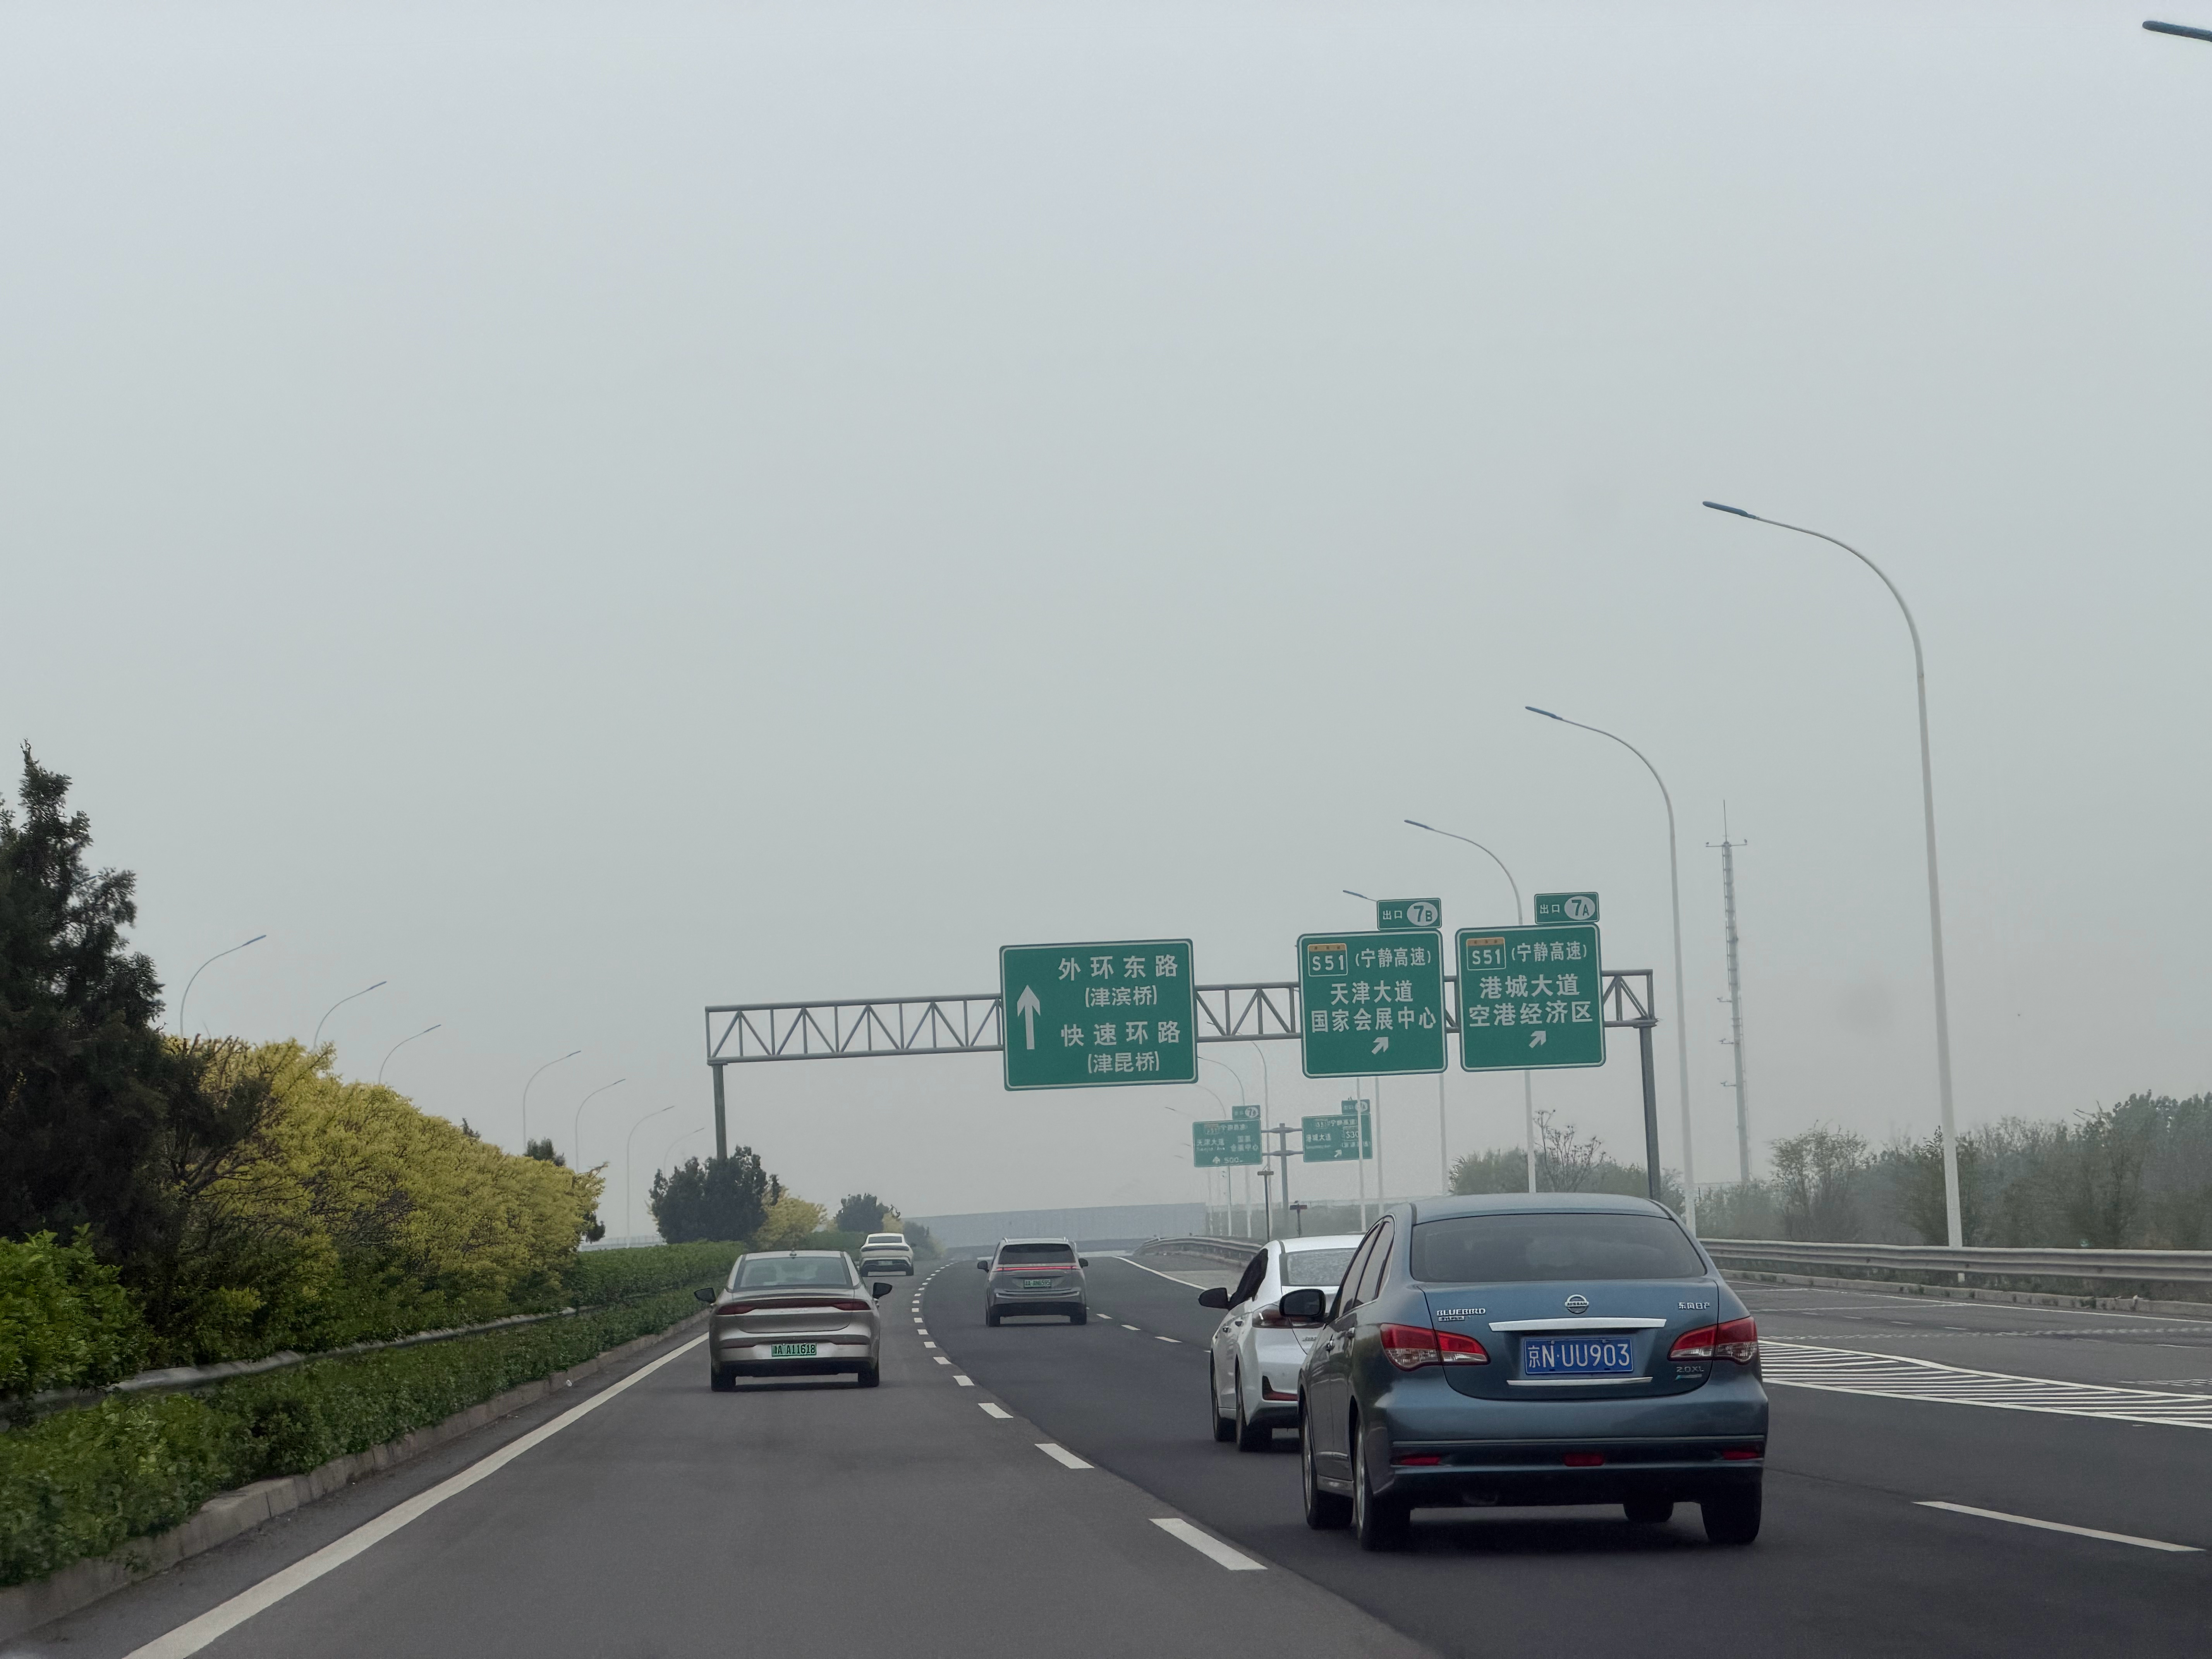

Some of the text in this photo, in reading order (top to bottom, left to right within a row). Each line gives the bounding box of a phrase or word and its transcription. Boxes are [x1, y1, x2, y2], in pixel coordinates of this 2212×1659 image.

[1382, 905, 1433, 922] 出口 7B
[1540, 899, 1589, 916] 出口 7A
[1312, 947, 1431, 971] S51 (宁静高速)
[1472, 941, 1587, 965] S51 (宁静高速)
[1058, 954, 1178, 981] 外环东路
[1085, 985, 1157, 1007] (津滨桥)
[1331, 980, 1413, 1005] 天津大道
[1479, 973, 1580, 999] 港城大道
[1311, 1006, 1436, 1033] 国家会展中心
[1469, 1000, 1593, 1027] 空港经济区
[1061, 1020, 1180, 1047] 快速环路
[1088, 1051, 1159, 1073] (津昆桥)
